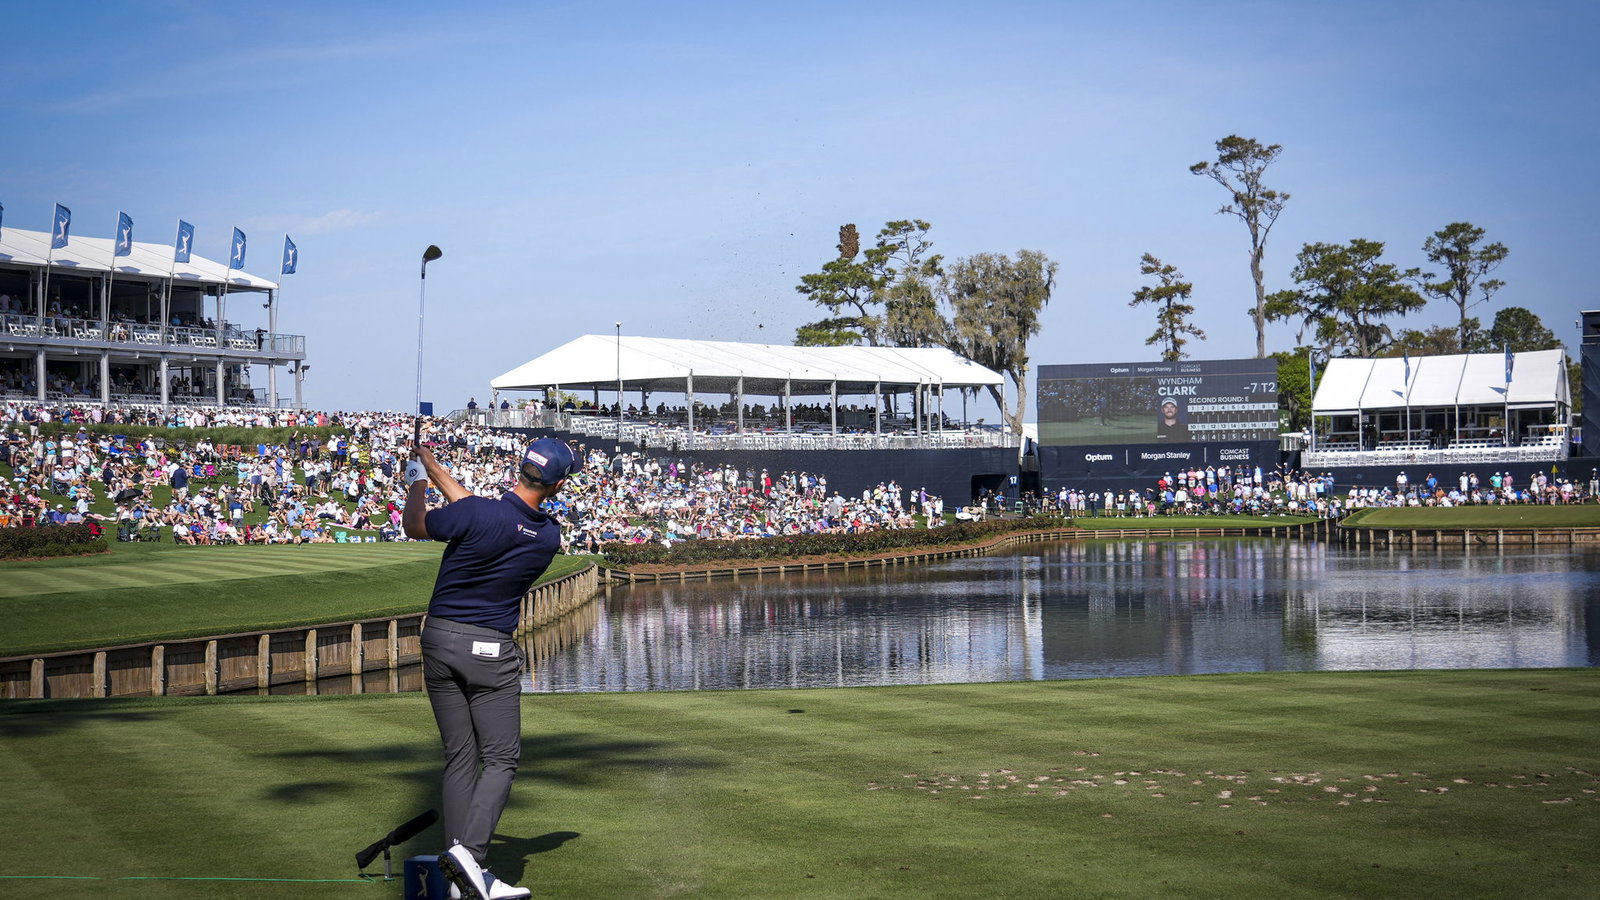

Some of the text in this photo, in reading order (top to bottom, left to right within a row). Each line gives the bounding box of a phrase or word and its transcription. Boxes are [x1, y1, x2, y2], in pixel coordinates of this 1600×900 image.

[1158, 386, 1197, 396] CLARK
[1244, 382, 1276, 393] -7 T2
[1085, 454, 1112, 462] Optum
[1010, 476, 1017, 484] 17
